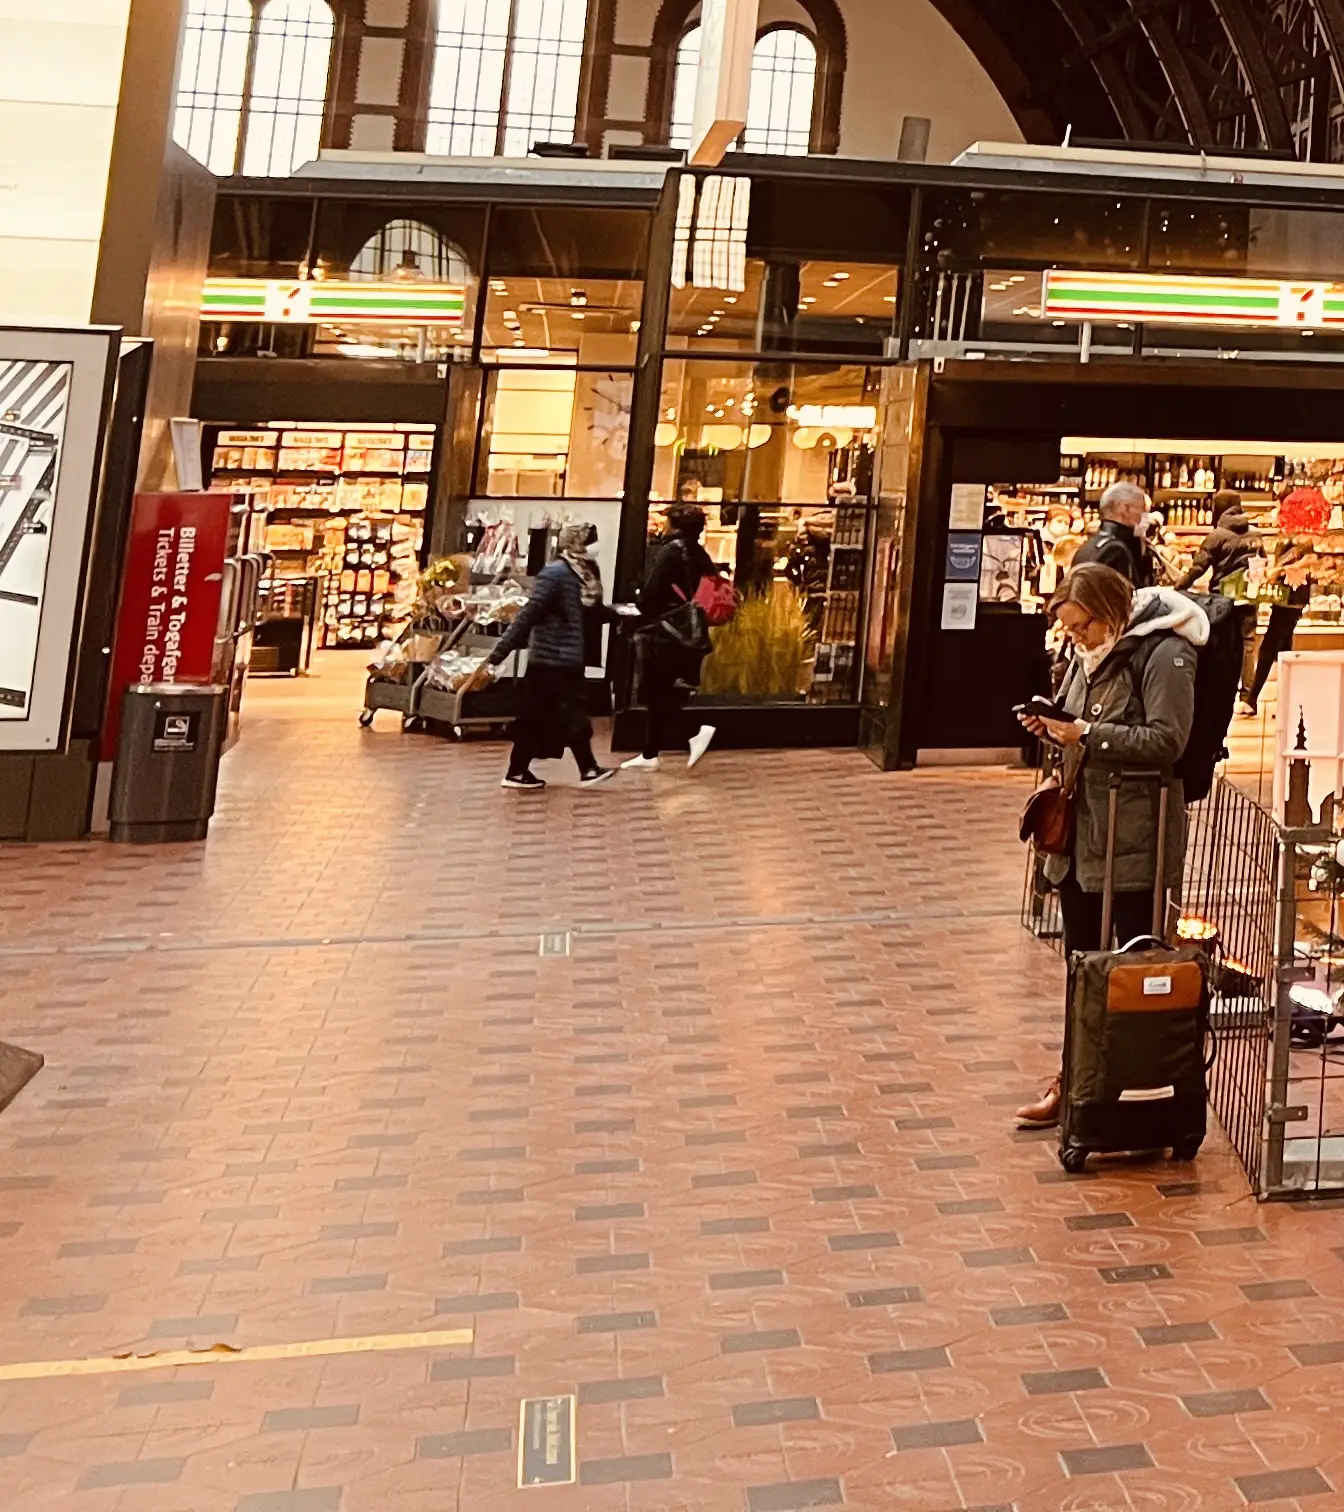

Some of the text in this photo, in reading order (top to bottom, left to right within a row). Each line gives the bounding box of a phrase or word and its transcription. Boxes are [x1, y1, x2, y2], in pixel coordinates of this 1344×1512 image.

[152, 526, 175, 581] Tickets
[173, 526, 197, 592] Billetter
[151, 585, 168, 598] &
[171, 595, 188, 609] &
[145, 602, 166, 640] Train
